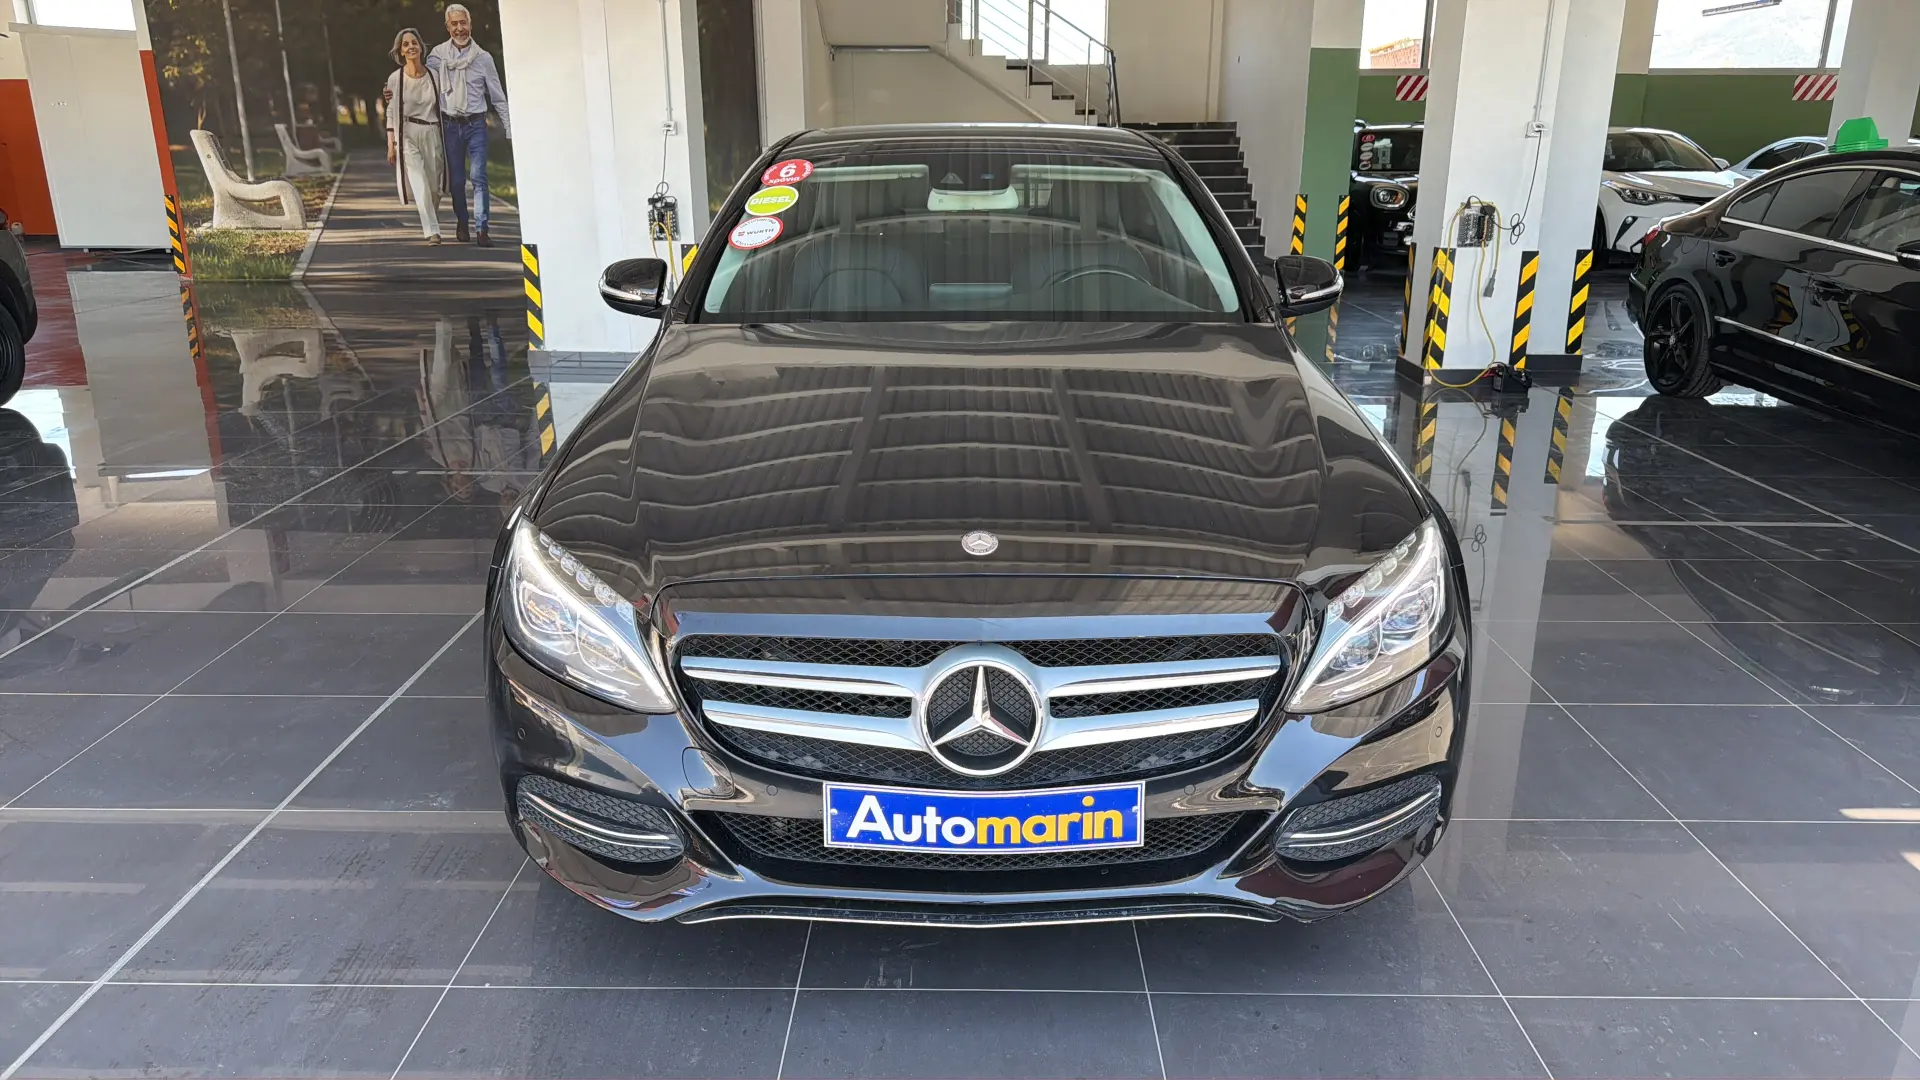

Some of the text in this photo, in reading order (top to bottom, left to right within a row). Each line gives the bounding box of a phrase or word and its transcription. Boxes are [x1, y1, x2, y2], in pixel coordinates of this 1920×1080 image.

[780, 165, 797, 178] 6
[750, 196, 791, 204] DIESEL
[846, 795, 1123, 845] Automarin
